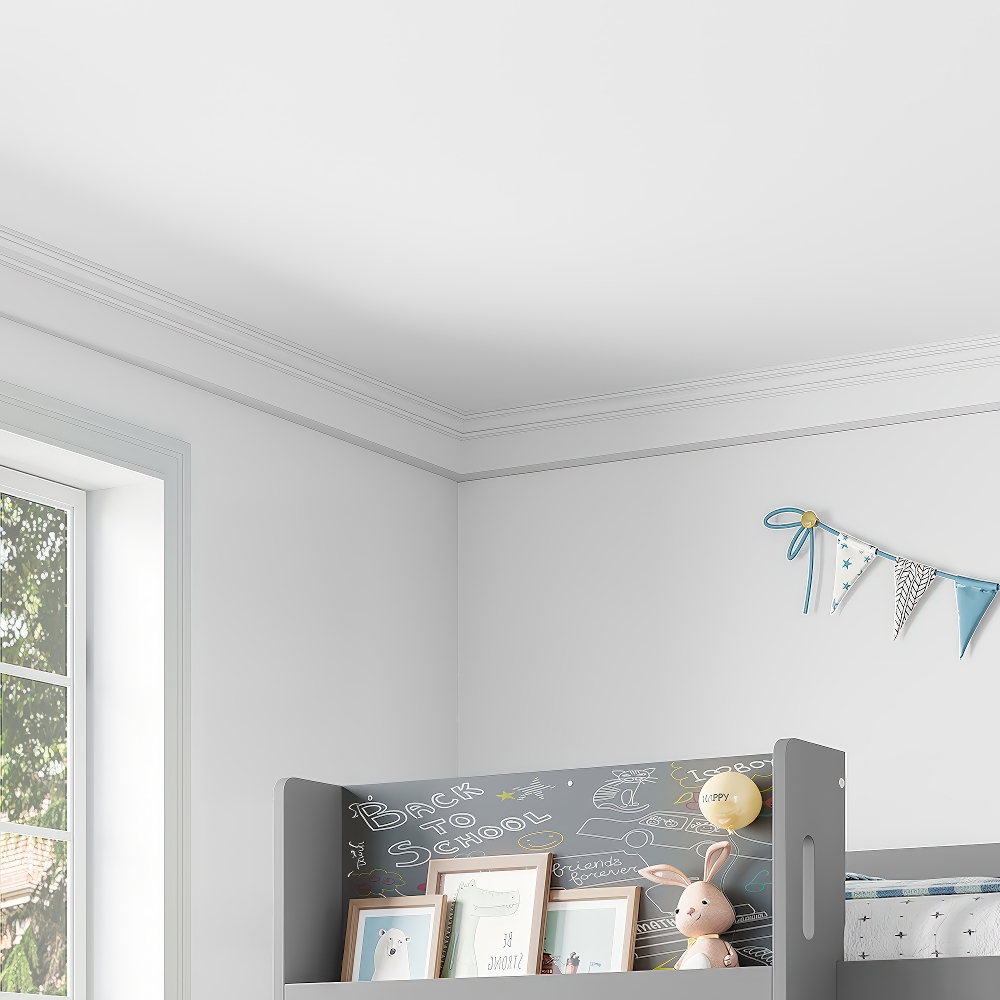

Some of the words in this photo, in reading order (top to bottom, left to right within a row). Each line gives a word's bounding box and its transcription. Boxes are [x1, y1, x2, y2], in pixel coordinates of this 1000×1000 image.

[357, 782, 485, 832] BACK
[702, 793, 730, 803] HAPPY
[419, 812, 476, 836] TO
[387, 811, 552, 868] SCHOOL
[569, 865, 638, 887] forever
